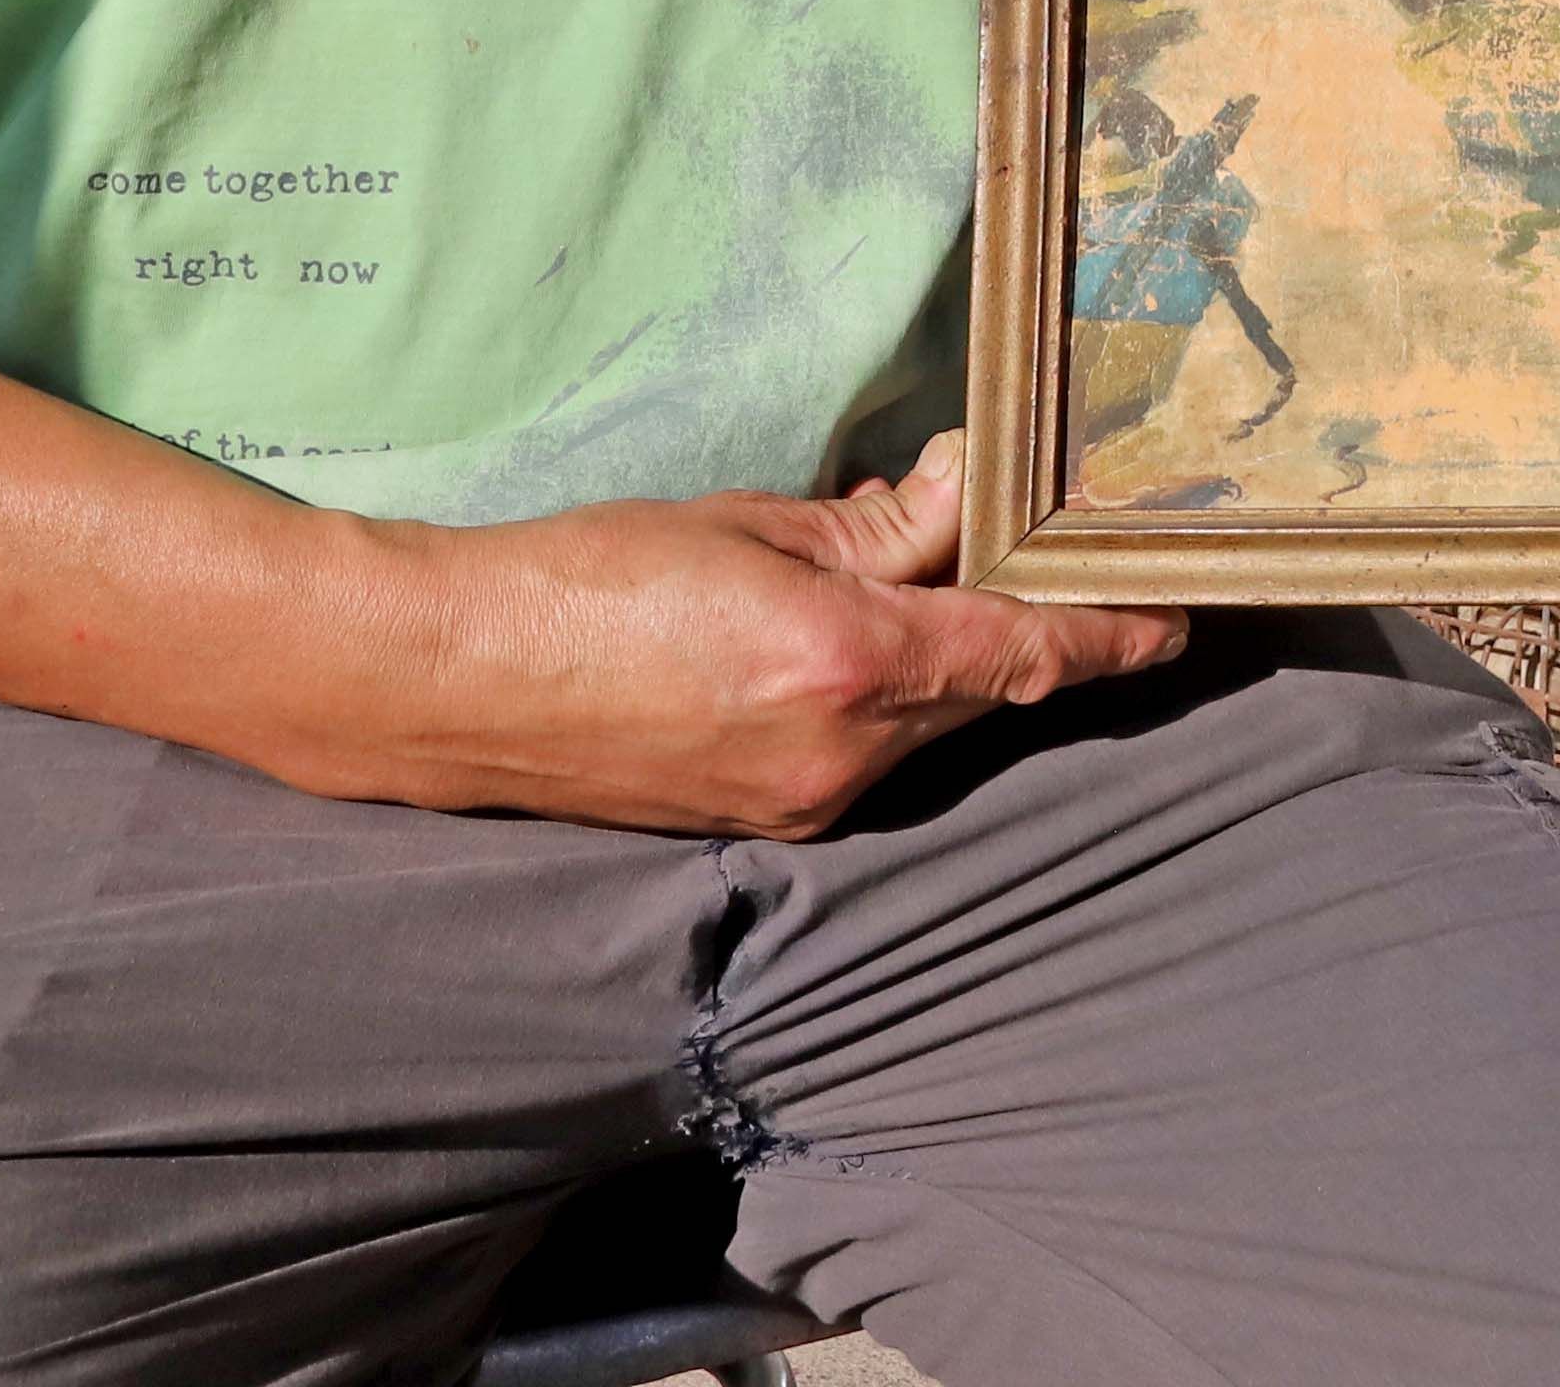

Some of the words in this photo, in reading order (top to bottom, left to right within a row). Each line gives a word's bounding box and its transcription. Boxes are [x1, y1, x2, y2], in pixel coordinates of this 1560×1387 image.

[86, 166, 186, 196] come
[202, 164, 400, 205] together
[133, 250, 260, 287] right
[300, 257, 380, 285] now
